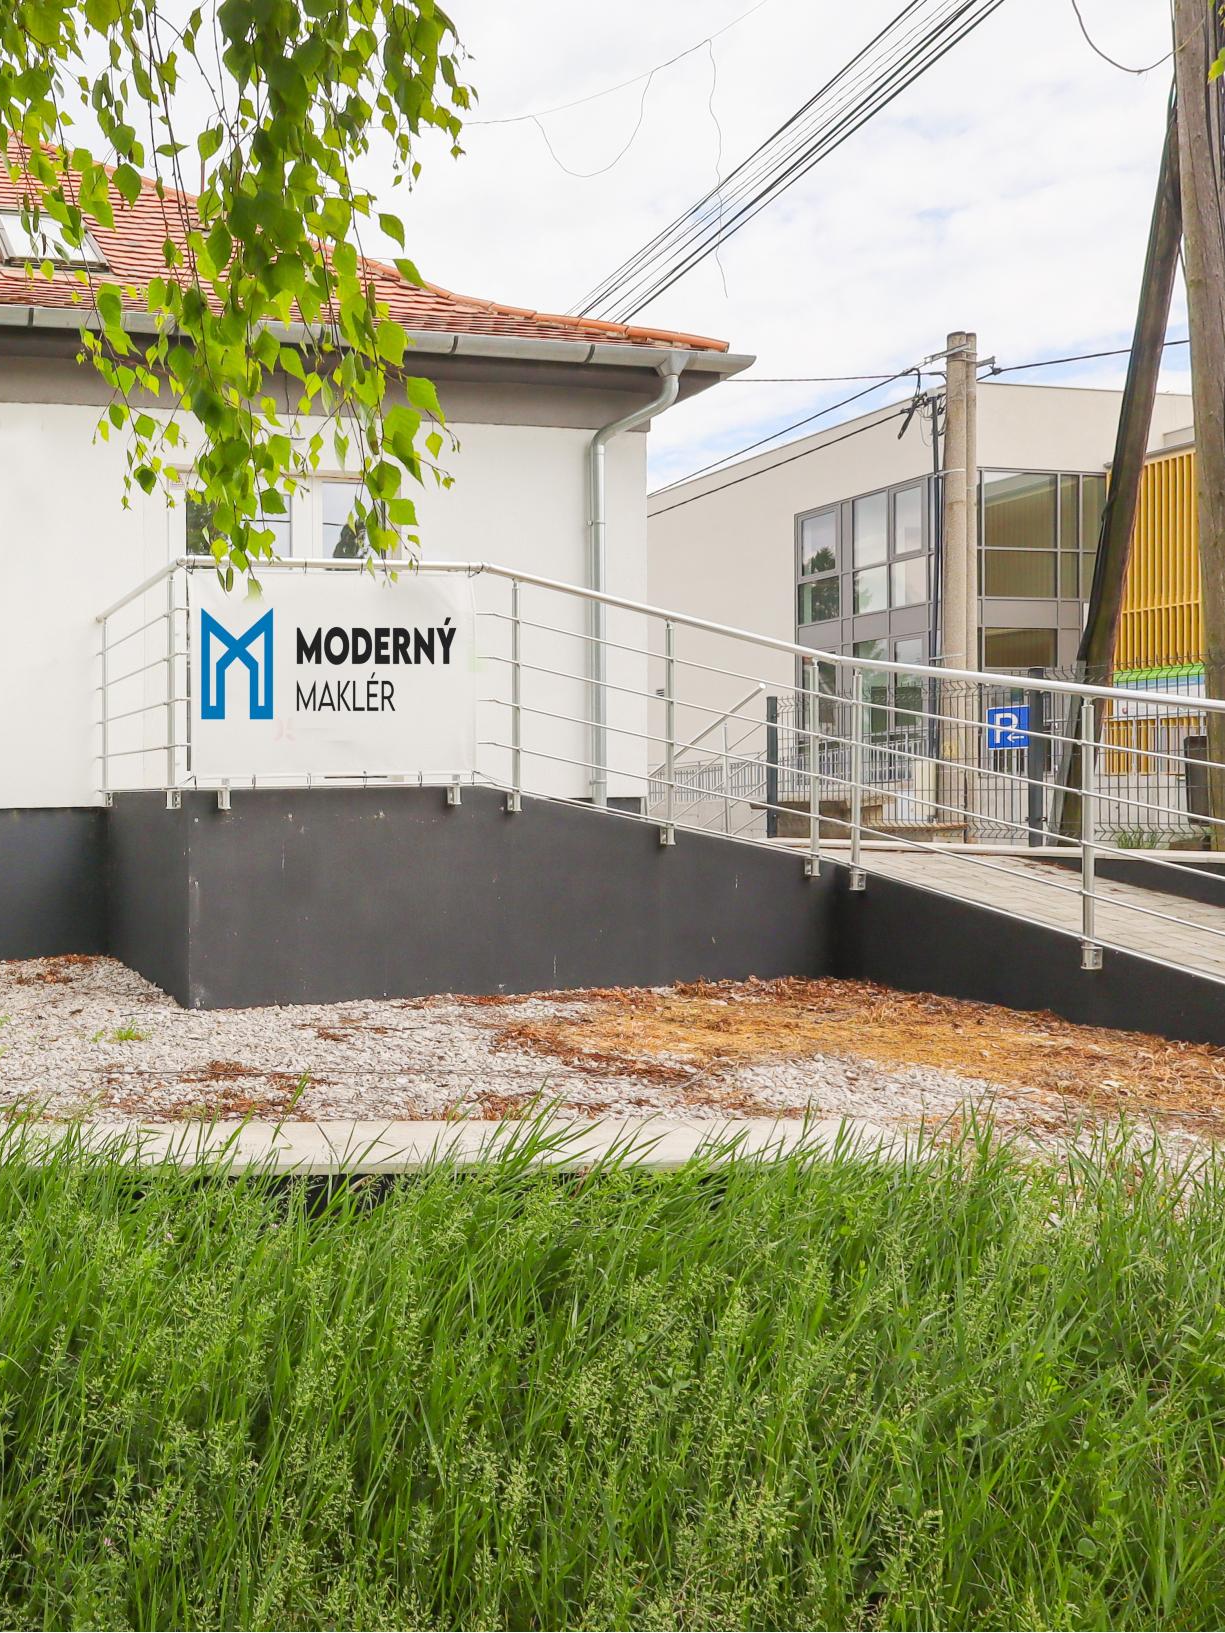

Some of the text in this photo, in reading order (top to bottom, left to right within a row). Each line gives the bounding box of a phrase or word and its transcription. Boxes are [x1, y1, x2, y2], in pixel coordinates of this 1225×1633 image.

[296, 617, 456, 665] MODERNÝ
[296, 671, 395, 711] MAKLÉR
[993, 712, 1018, 744] P
